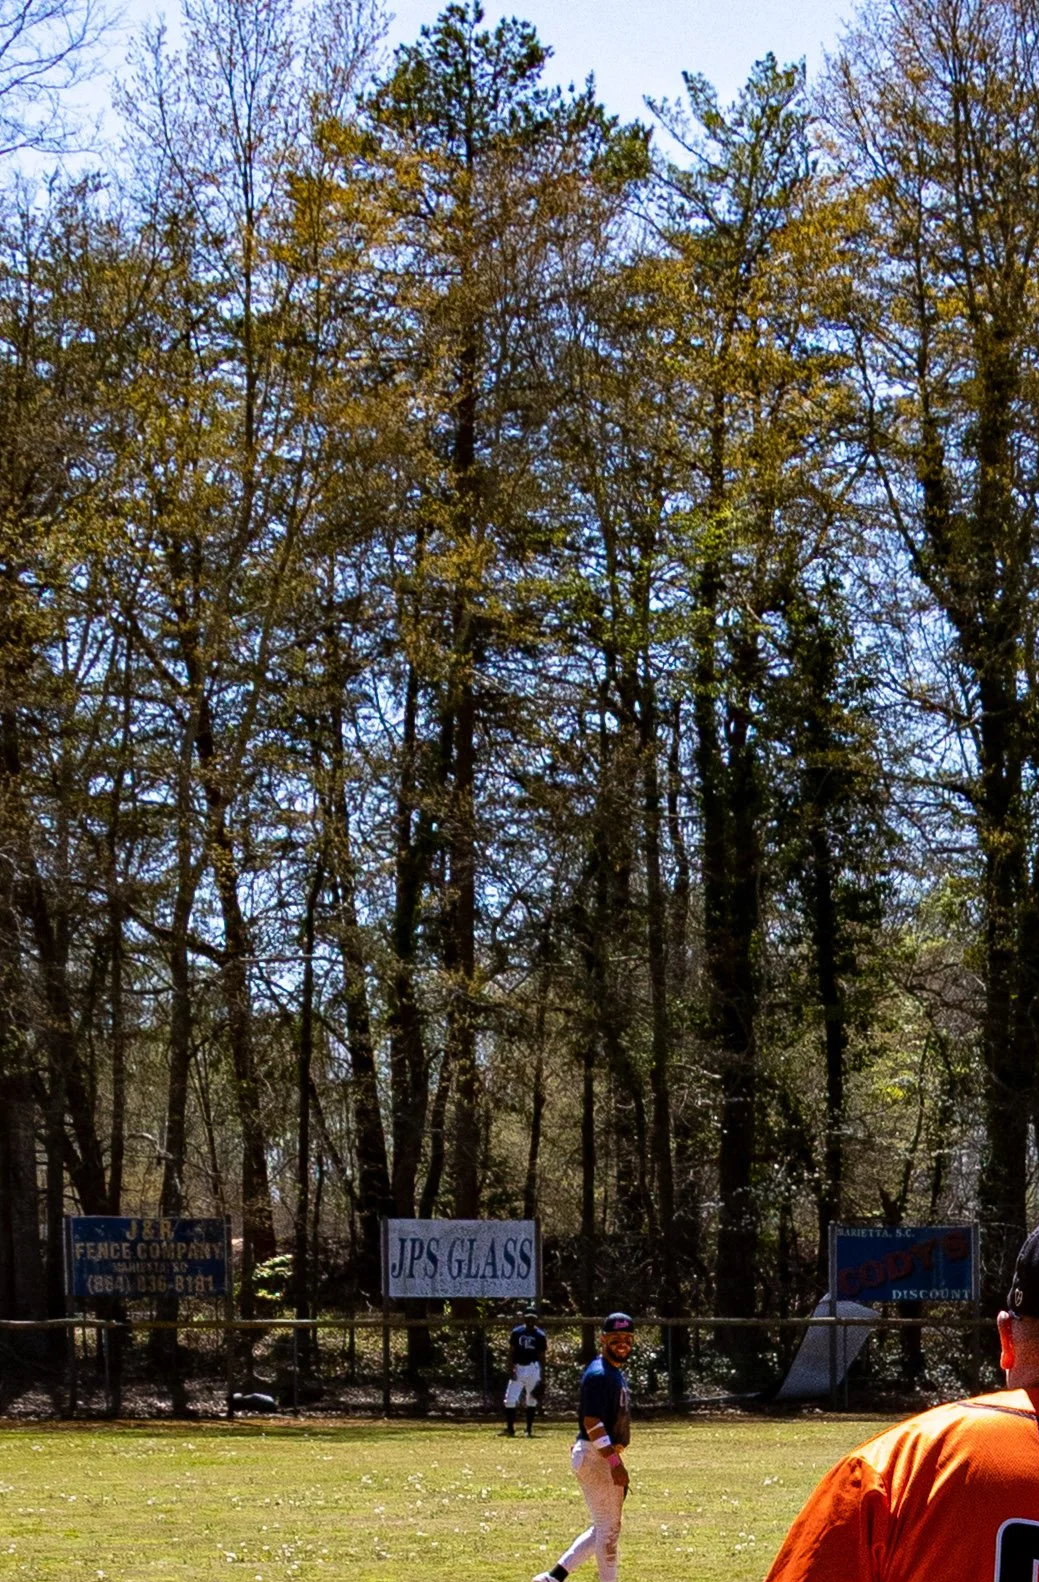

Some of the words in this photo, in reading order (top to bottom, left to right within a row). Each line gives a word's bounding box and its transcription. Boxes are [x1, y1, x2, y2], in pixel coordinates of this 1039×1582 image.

[126, 1220, 137, 1240] J
[142, 1220, 154, 1240] &
[74, 1242, 131, 1260] FENCE
[136, 1243, 225, 1260] COMPANY
[391, 1237, 440, 1279] JPS
[447, 1237, 533, 1280] GLASS
[892, 1289, 971, 1300] DISCOUNT
